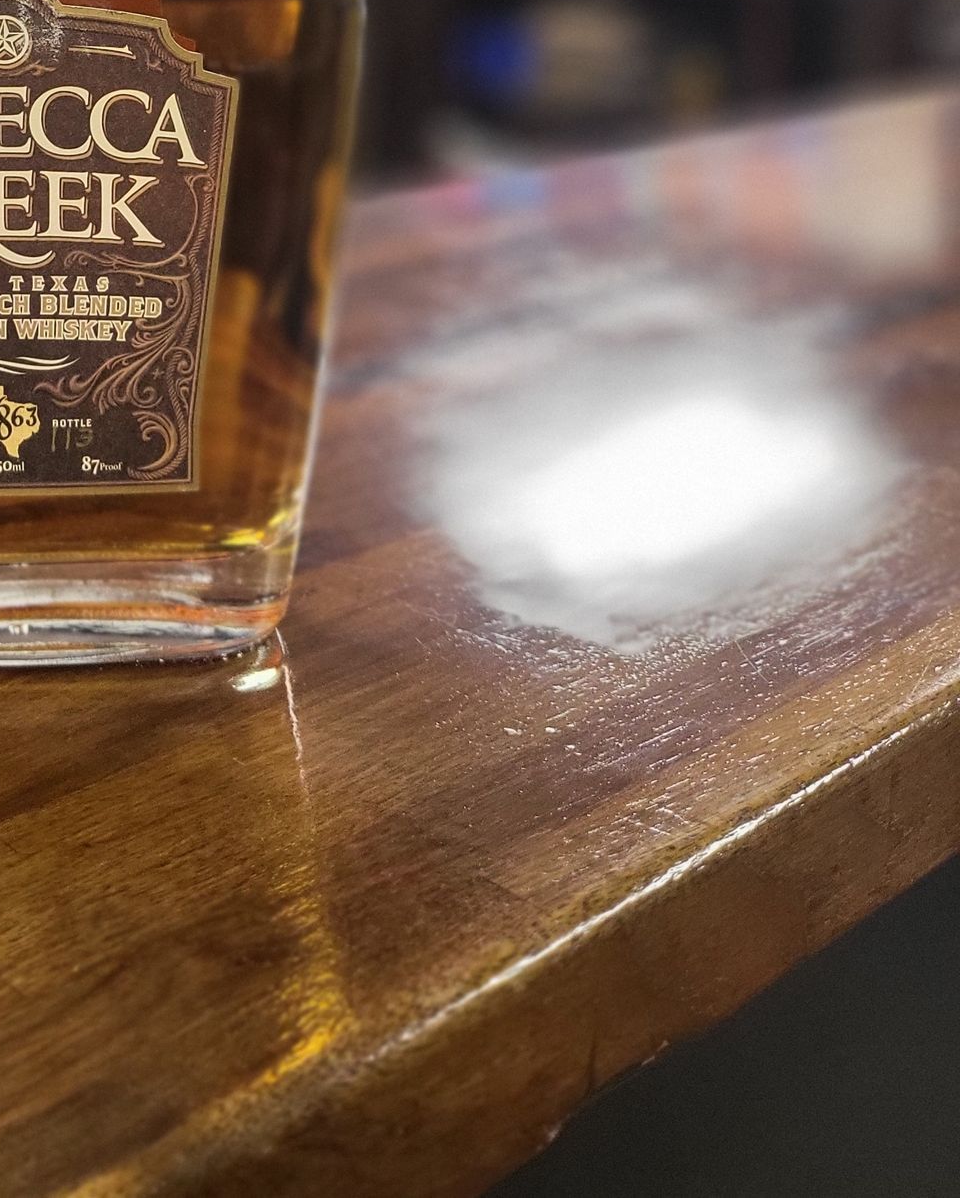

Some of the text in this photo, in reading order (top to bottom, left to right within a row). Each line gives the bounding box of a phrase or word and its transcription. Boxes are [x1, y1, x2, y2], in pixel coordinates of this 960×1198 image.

[9, 275, 110, 292] TEXAS
[40, 294, 162, 318] BLENDED
[13, 319, 133, 341] WHISKEY
[52, 418, 92, 428] BOTTLE
